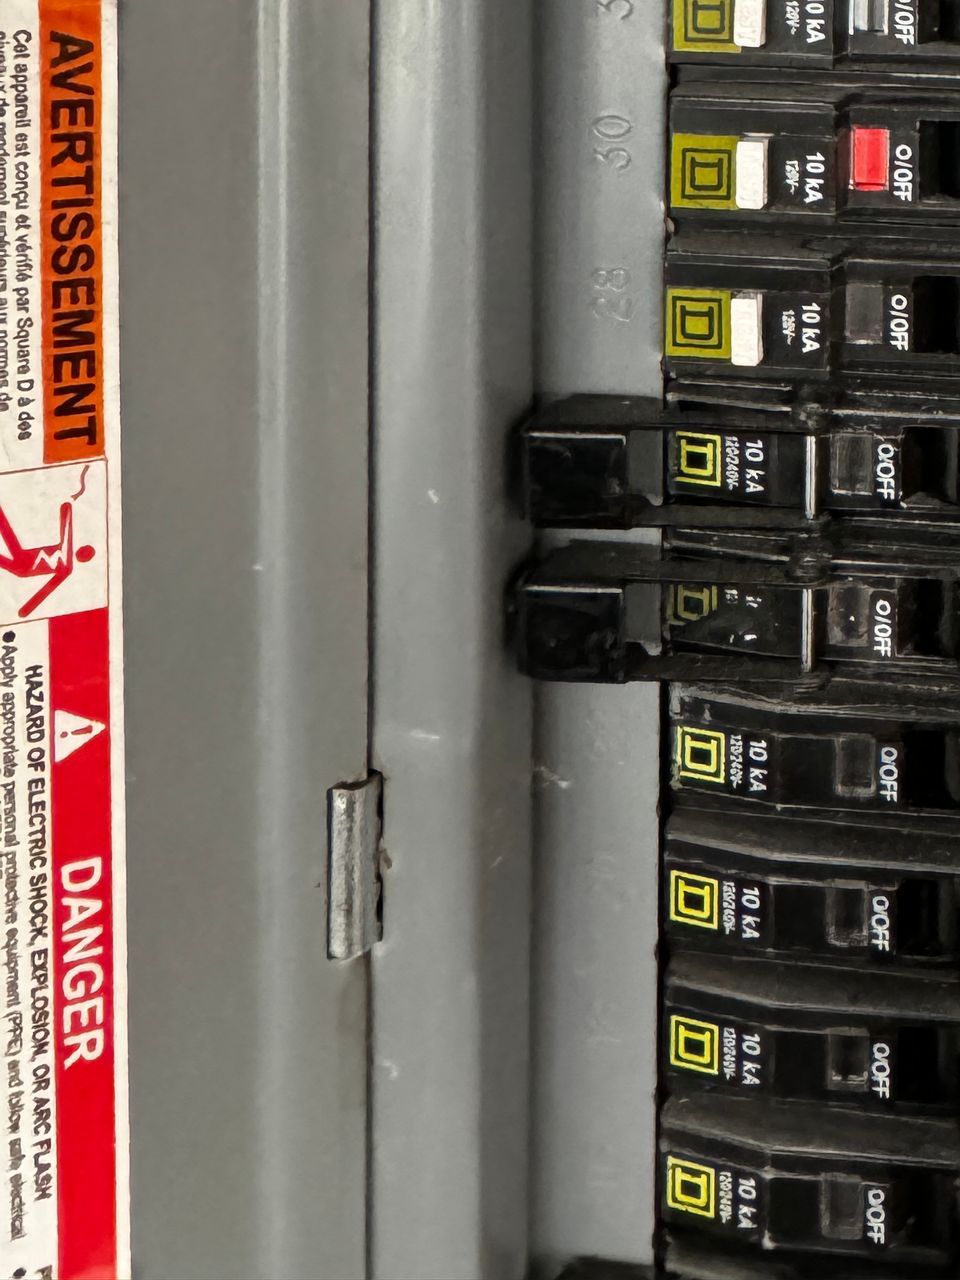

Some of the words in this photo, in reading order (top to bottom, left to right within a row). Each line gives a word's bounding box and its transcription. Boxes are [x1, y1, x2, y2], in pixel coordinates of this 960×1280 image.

[13, 30, 32, 58] Cet
[805, 20, 825, 44] kA
[15, 133, 30, 158] est
[593, 115, 633, 170] 30
[805, 153, 825, 176] 10
[11, 162, 30, 209] conçu
[804, 179, 822, 204] kA
[51, 30, 96, 445] AVERTISSEMENT
[13, 287, 32, 313] par
[802, 302, 821, 325] 10
[13, 318, 33, 374] Square
[802, 329, 820, 354] kA
[18, 380, 34, 391] D
[17, 412, 34, 440] des
[746, 439, 763, 462] 10
[746, 467, 764, 494] kA
[1, 645, 18, 687] Apply
[25, 665, 45, 742] HAZARD
[28, 748, 45, 771] OF
[748, 767, 767, 793] kA
[28, 779, 47, 870] ELECTRIC
[742, 887, 760, 910] 10
[742, 915, 760, 939] kA
[60, 856, 104, 1070] DANGER
[742, 1033, 760, 1056] 10
[30, 1064, 50, 1096] OR
[741, 1060, 761, 1086] kA
[33, 1097, 51, 1135] ARC
[31, 1138, 52, 1202] FLASH
[738, 1177, 755, 1201] 10
[737, 1204, 756, 1229] kA
